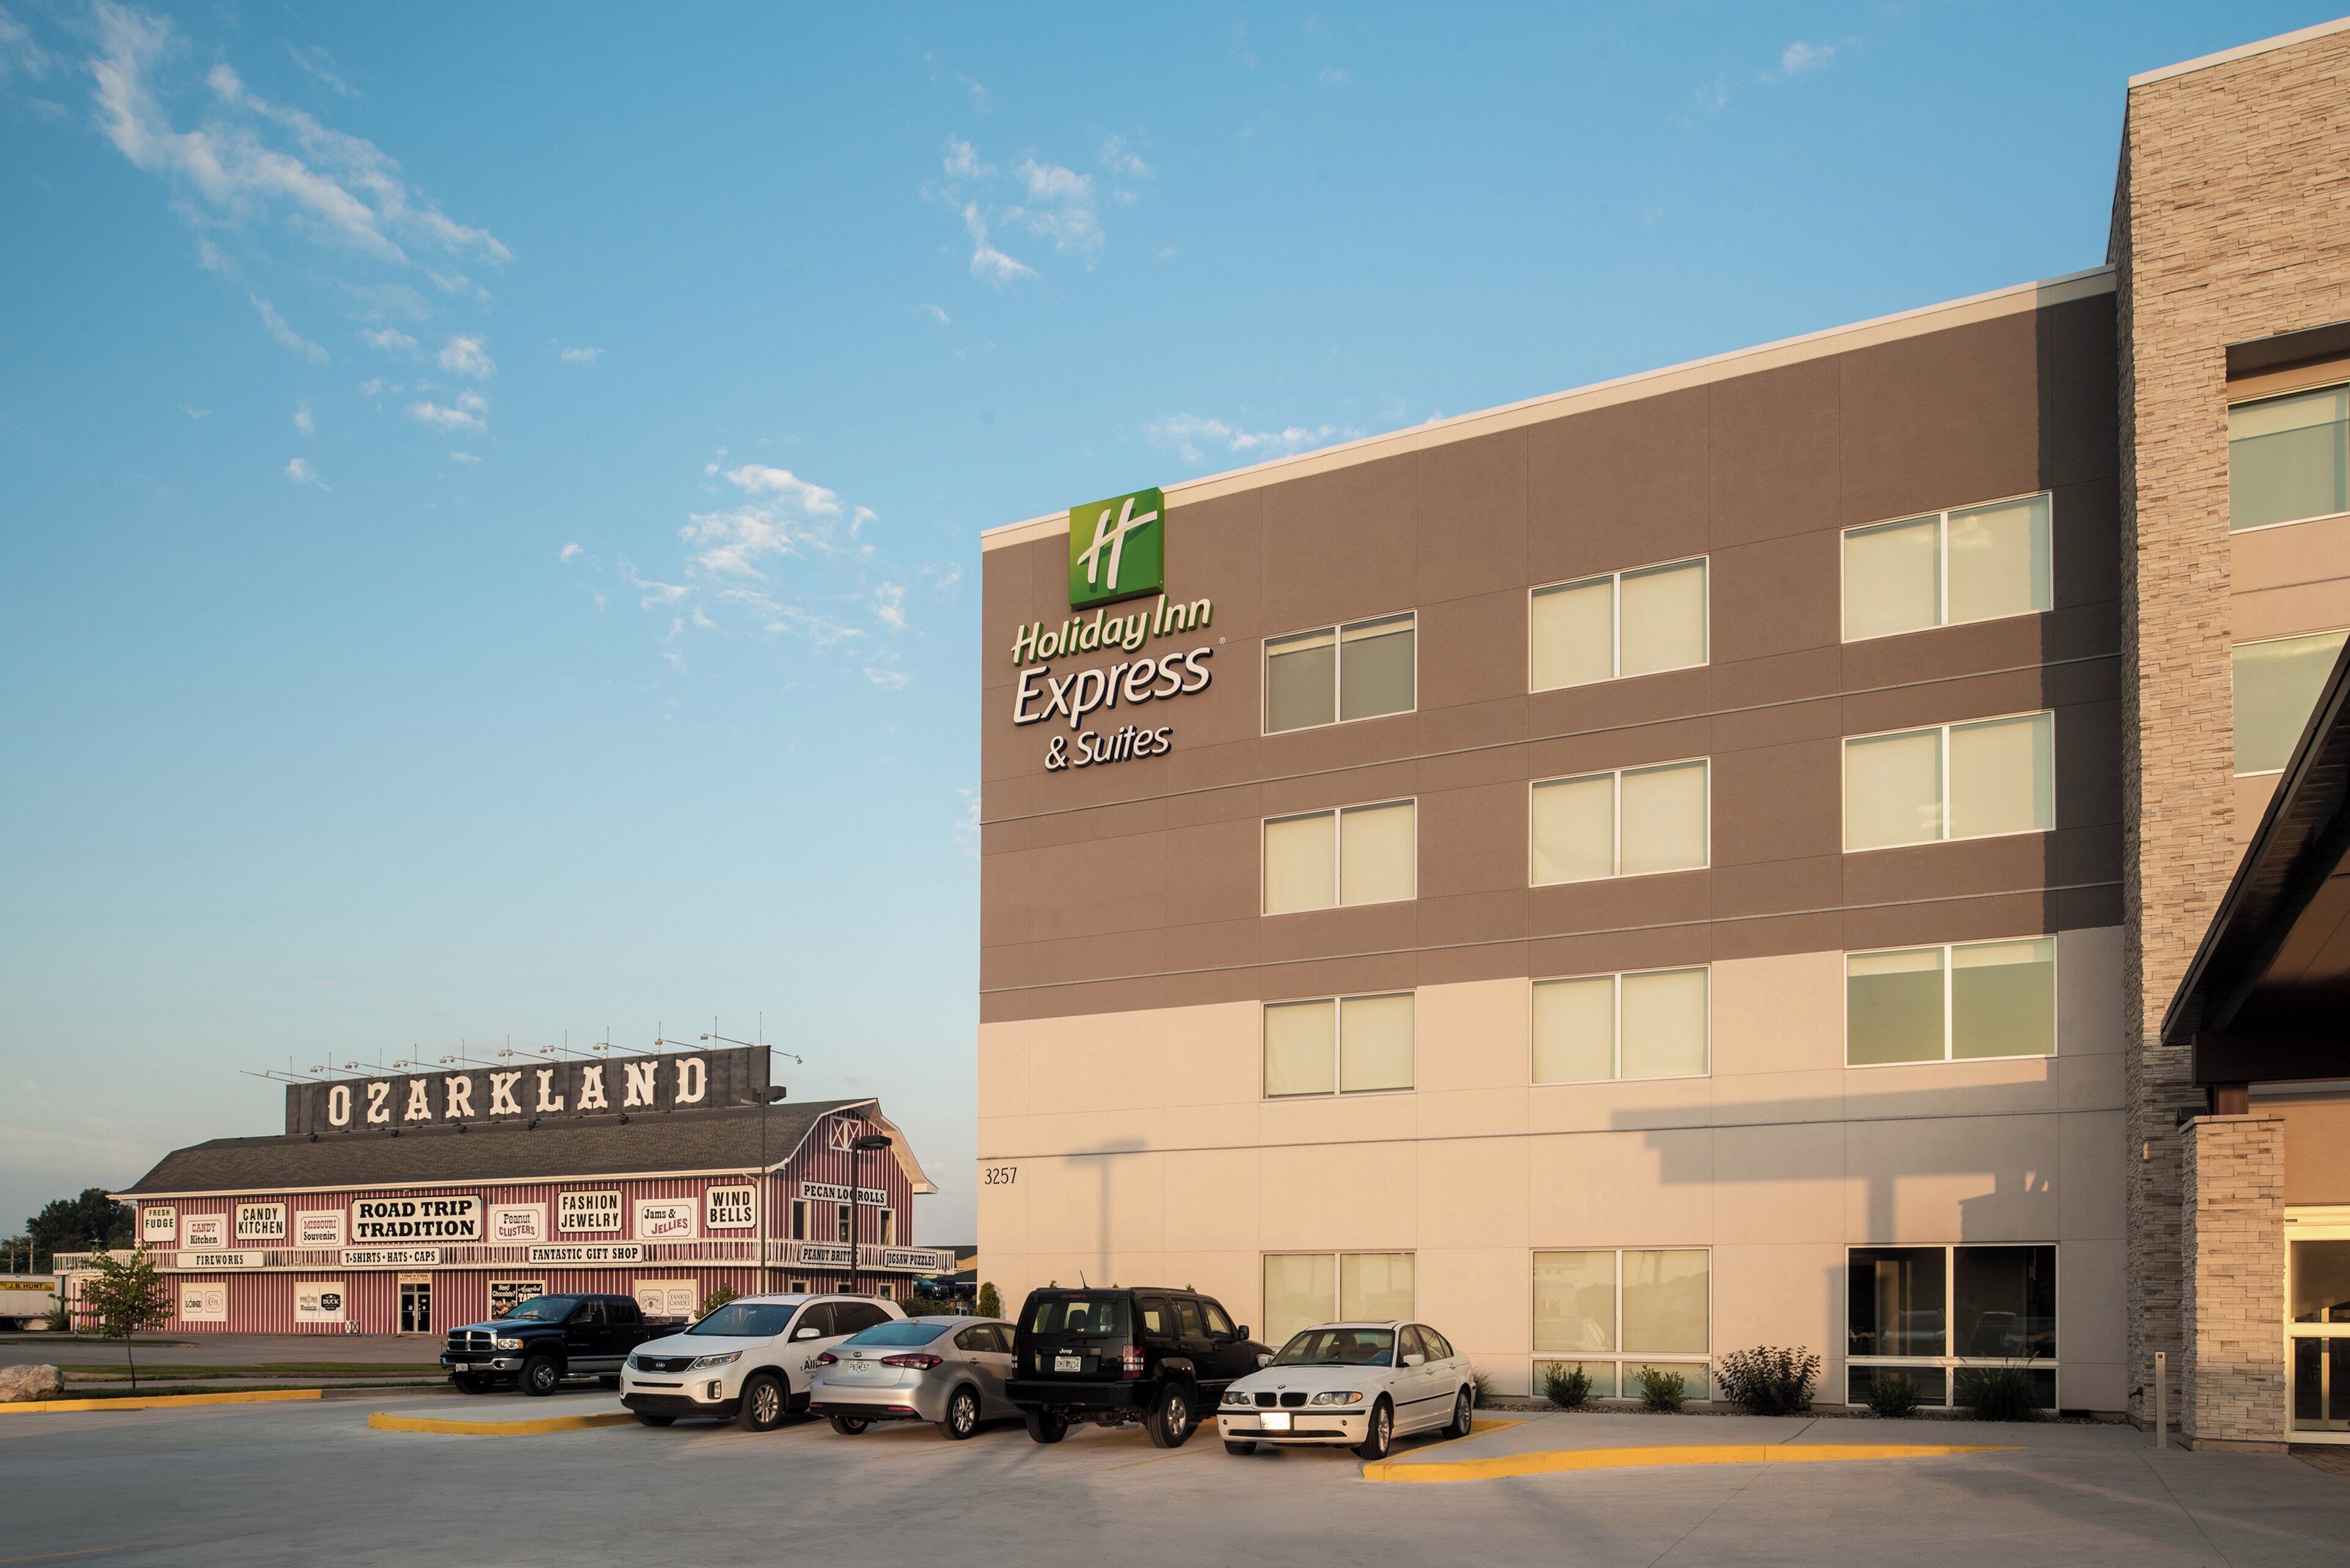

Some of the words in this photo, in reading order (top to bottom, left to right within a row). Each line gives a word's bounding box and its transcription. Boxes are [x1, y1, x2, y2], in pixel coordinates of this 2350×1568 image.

[1011, 608, 1151, 666] Holiday
[1154, 594, 1214, 638] Inn
[1013, 647, 1214, 730] Express
[1044, 735, 1069, 772] &
[1073, 725, 1173, 767] Suites
[327, 1057, 708, 1127] OZARKLAND
[984, 1167, 1017, 1185] 3257
[712, 1191, 750, 1206] WIND
[804, 1185, 835, 1198] PECAN
[858, 1191, 884, 1203] ROLLS
[360, 1202, 416, 1218] ROAD
[421, 1200, 472, 1217] TRIP
[562, 1195, 617, 1210] FASHION
[243, 1208, 278, 1221] CANDY
[504, 1214, 530, 1224] Peanut
[561, 1212, 619, 1228] JEWELRY
[644, 1209, 666, 1219] Jams
[668, 1209, 676, 1219] &
[710, 1207, 752, 1223] BELLS
[145, 1219, 174, 1228] FUDGE
[192, 1223, 216, 1233] CANDY
[238, 1221, 283, 1234] KITCHEN
[304, 1220, 337, 1230] MISSOURI
[357, 1220, 474, 1238] TRADITION
[651, 1218, 688, 1234] JELLIES
[304, 1231, 337, 1241] Souvenirs
[499, 1225, 535, 1237] CLUSTERS
[190, 1234, 217, 1244] Kitchen
[196, 1255, 244, 1265] FIREWORKS
[345, 1252, 381, 1263] T-SHIRTS
[387, 1251, 408, 1263] HATS
[414, 1250, 435, 1261] CAPS
[532, 1249, 582, 1260] FANTASTIC
[587, 1248, 608, 1260] GIFT
[613, 1247, 638, 1259] SHOP
[803, 1249, 830, 1261] PEANUT
[887, 1253, 909, 1264] JIGSAW
[910, 1255, 935, 1266] PUZZLES
